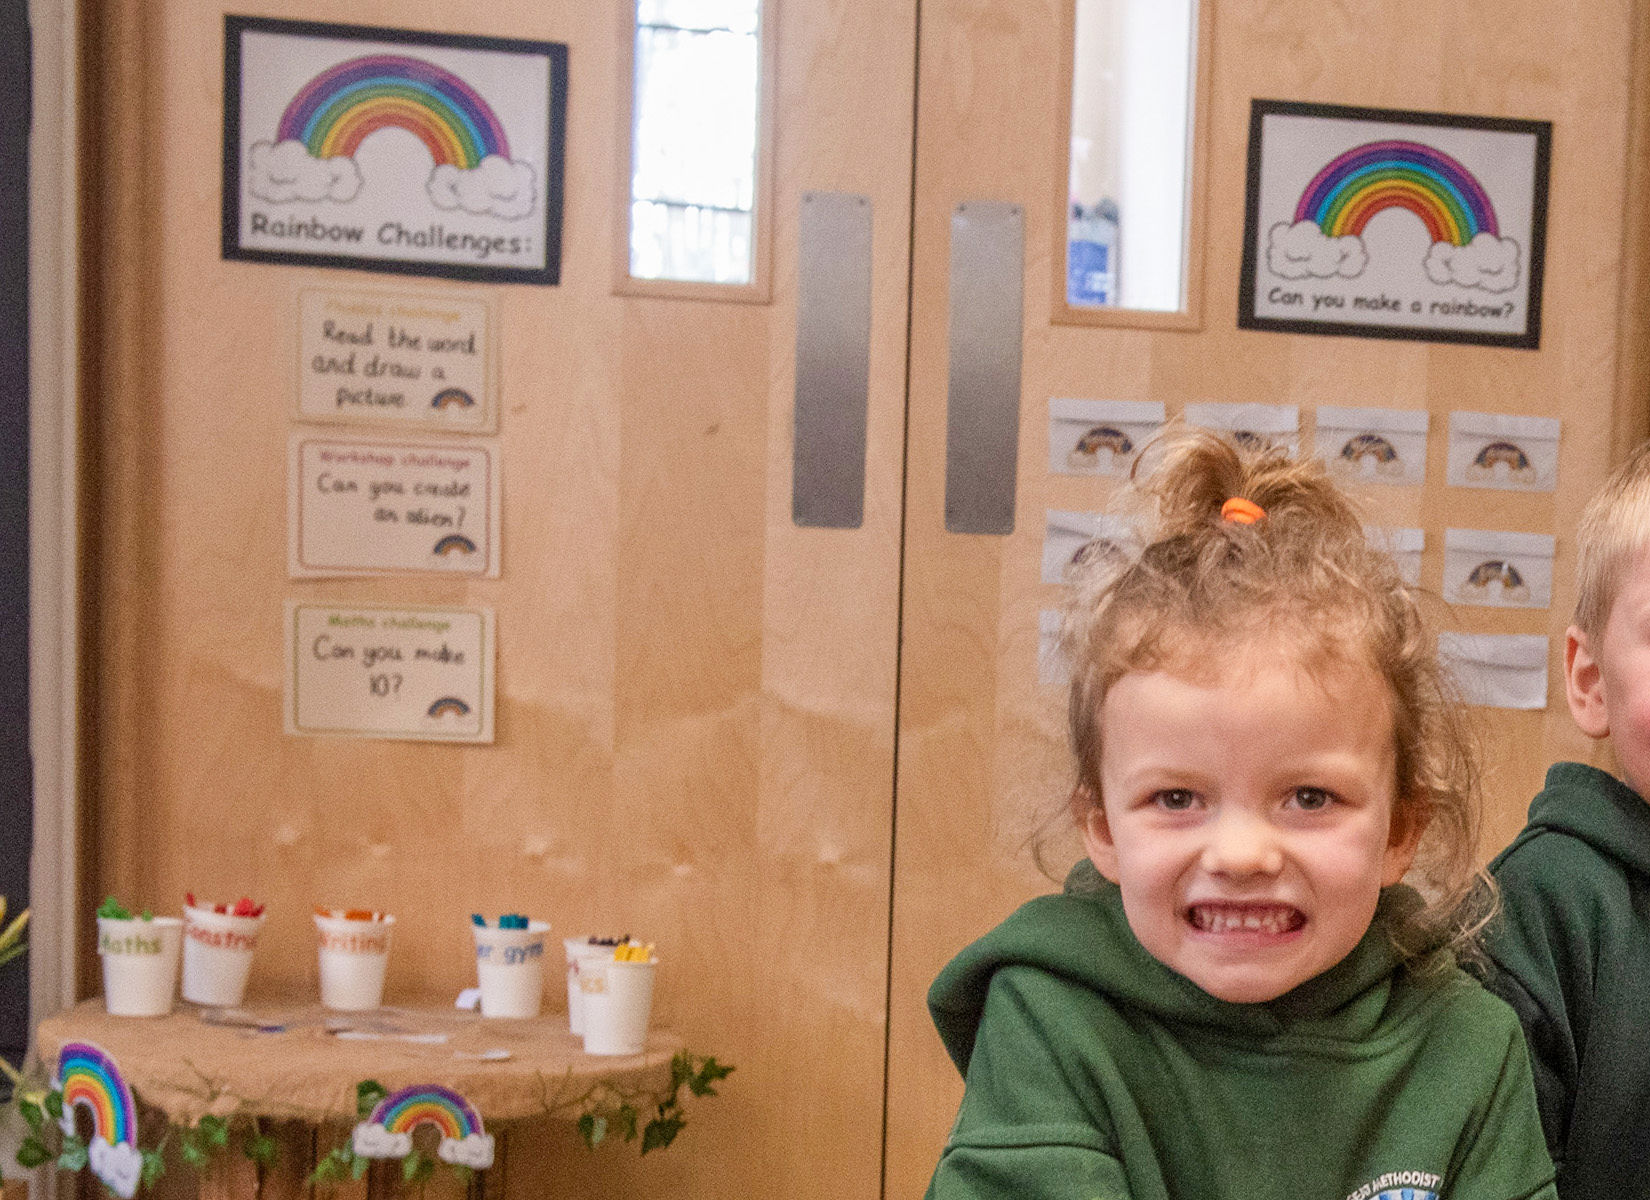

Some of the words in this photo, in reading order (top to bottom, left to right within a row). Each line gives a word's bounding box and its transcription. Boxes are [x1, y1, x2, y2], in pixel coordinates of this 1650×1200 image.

[250, 213, 363, 244] Rainbow
[377, 222, 532, 258] Challenges:
[1268, 287, 1303, 306] Can
[1312, 294, 1345, 311] you
[1353, 294, 1401, 312] make
[1410, 301, 1421, 313] a
[1429, 299, 1515, 318] rainbow?
[323, 319, 373, 345] Read
[388, 325, 421, 348] the
[427, 331, 476, 354] word
[363, 356, 421, 379] draw
[431, 367, 446, 379] a
[317, 473, 358, 494] Can
[368, 481, 404, 500] you
[413, 481, 470, 497] create
[374, 507, 399, 522] an
[313, 634, 354, 661] Can
[363, 646, 402, 668] you
[415, 641, 465, 664] make
[369, 672, 404, 697] 10?
[1372, 1171, 1440, 1191] METHODIST
